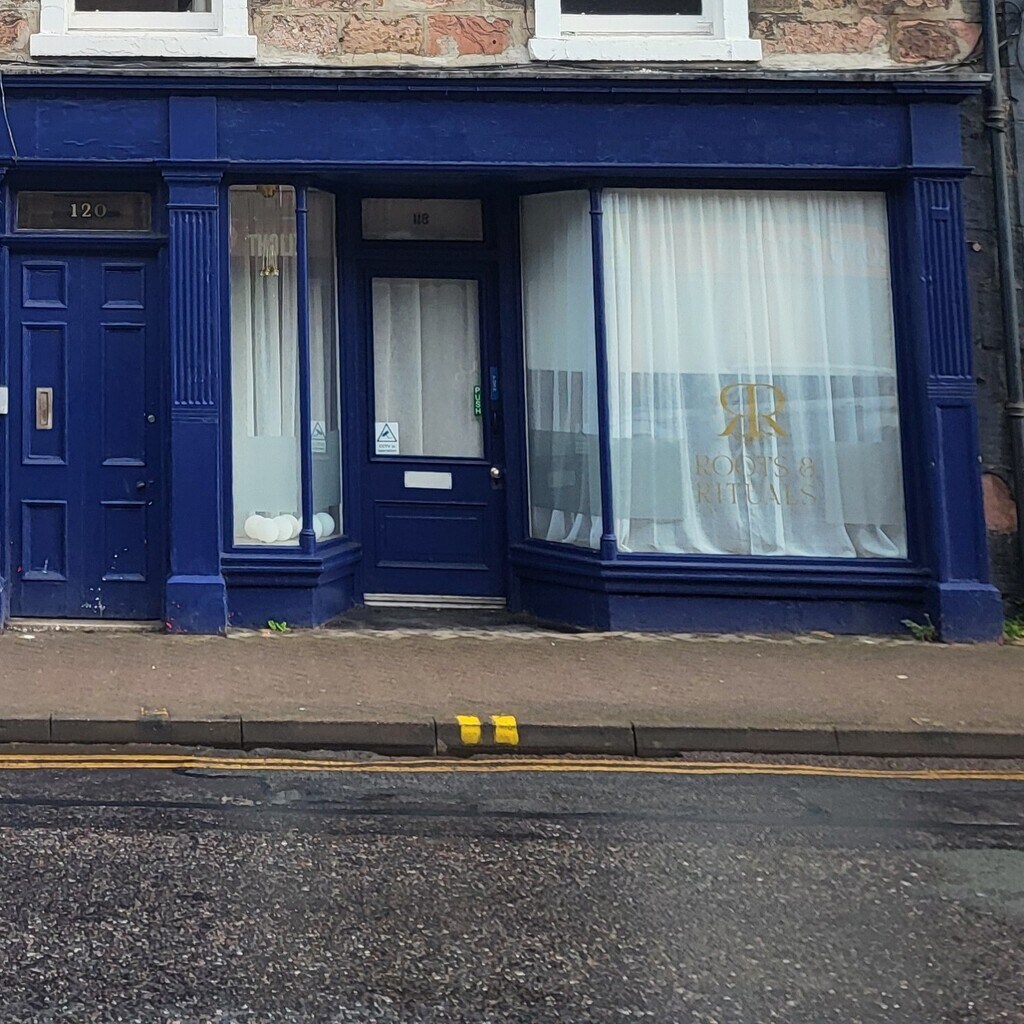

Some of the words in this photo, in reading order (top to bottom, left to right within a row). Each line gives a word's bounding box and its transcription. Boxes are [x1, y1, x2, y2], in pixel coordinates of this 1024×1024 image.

[70, 202, 107, 218] 120
[413, 212, 429, 225] 118
[474, 386, 482, 415] PUSH
[695, 454, 790, 478] ROOTS
[799, 456, 816, 478] &
[696, 482, 817, 505] RITUALS
